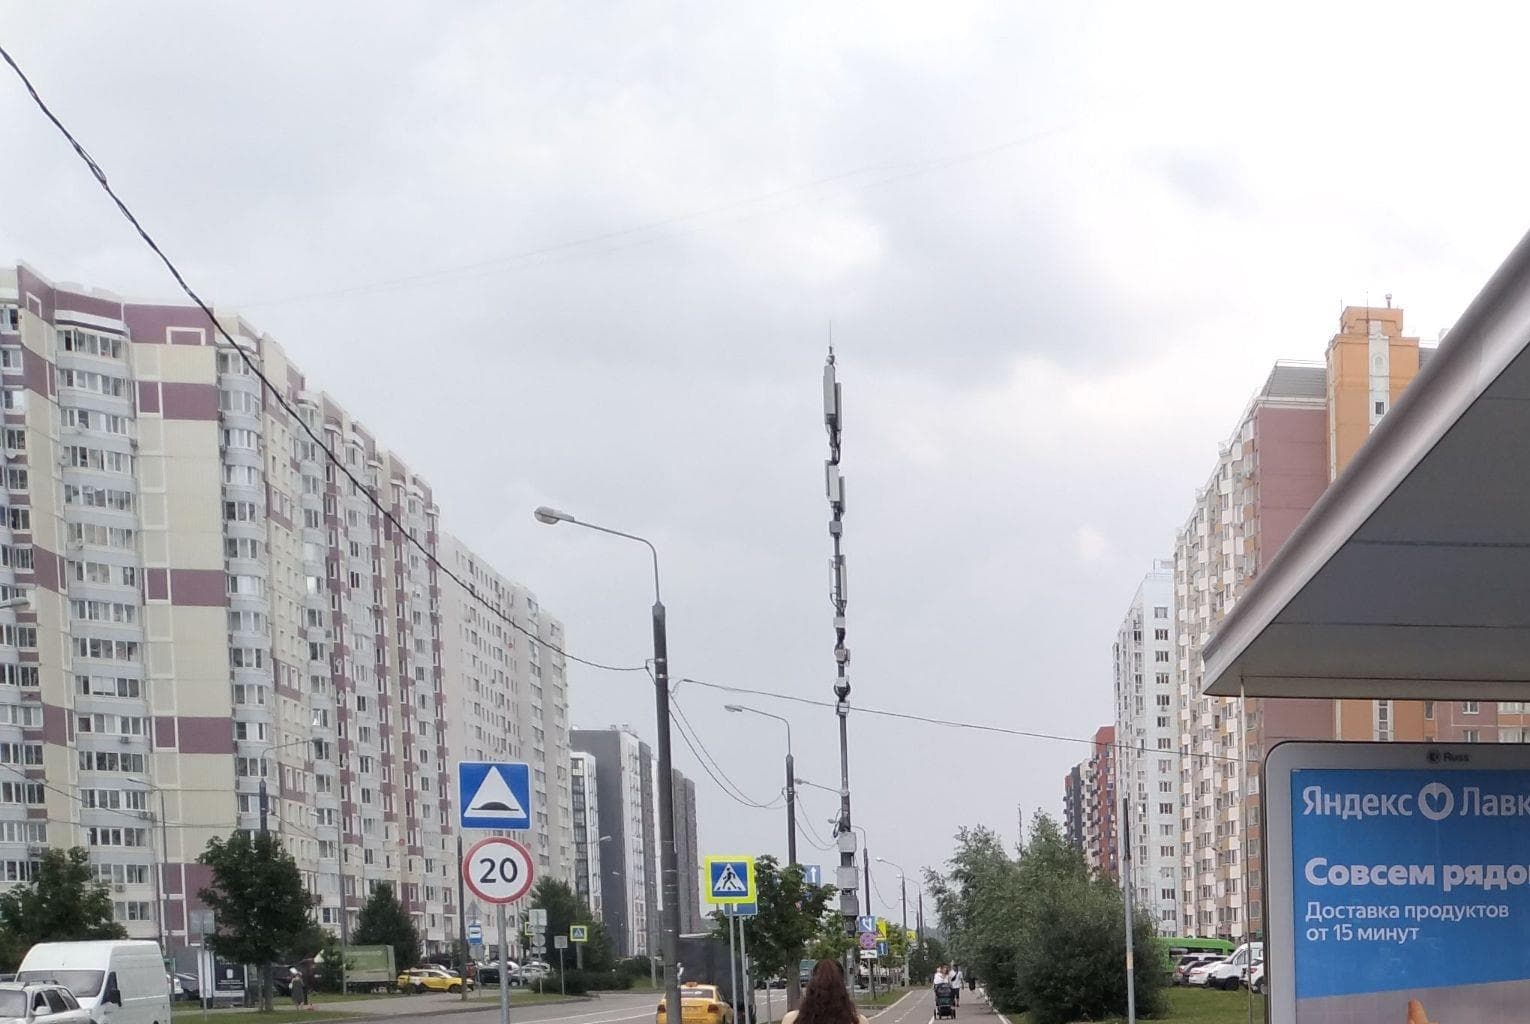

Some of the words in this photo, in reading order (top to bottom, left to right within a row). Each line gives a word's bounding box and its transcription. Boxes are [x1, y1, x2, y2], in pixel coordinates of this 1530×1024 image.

[1302, 785, 1413, 820] Яндекс
[479, 857, 518, 884] 20
[1304, 857, 1435, 886] Совсем
[1305, 901, 1400, 922] Доставка
[1404, 904, 1510, 922] продуктов
[1306, 927, 1329, 941] от
[1333, 924, 1354, 942] 15
[1357, 927, 1420, 944] минут
